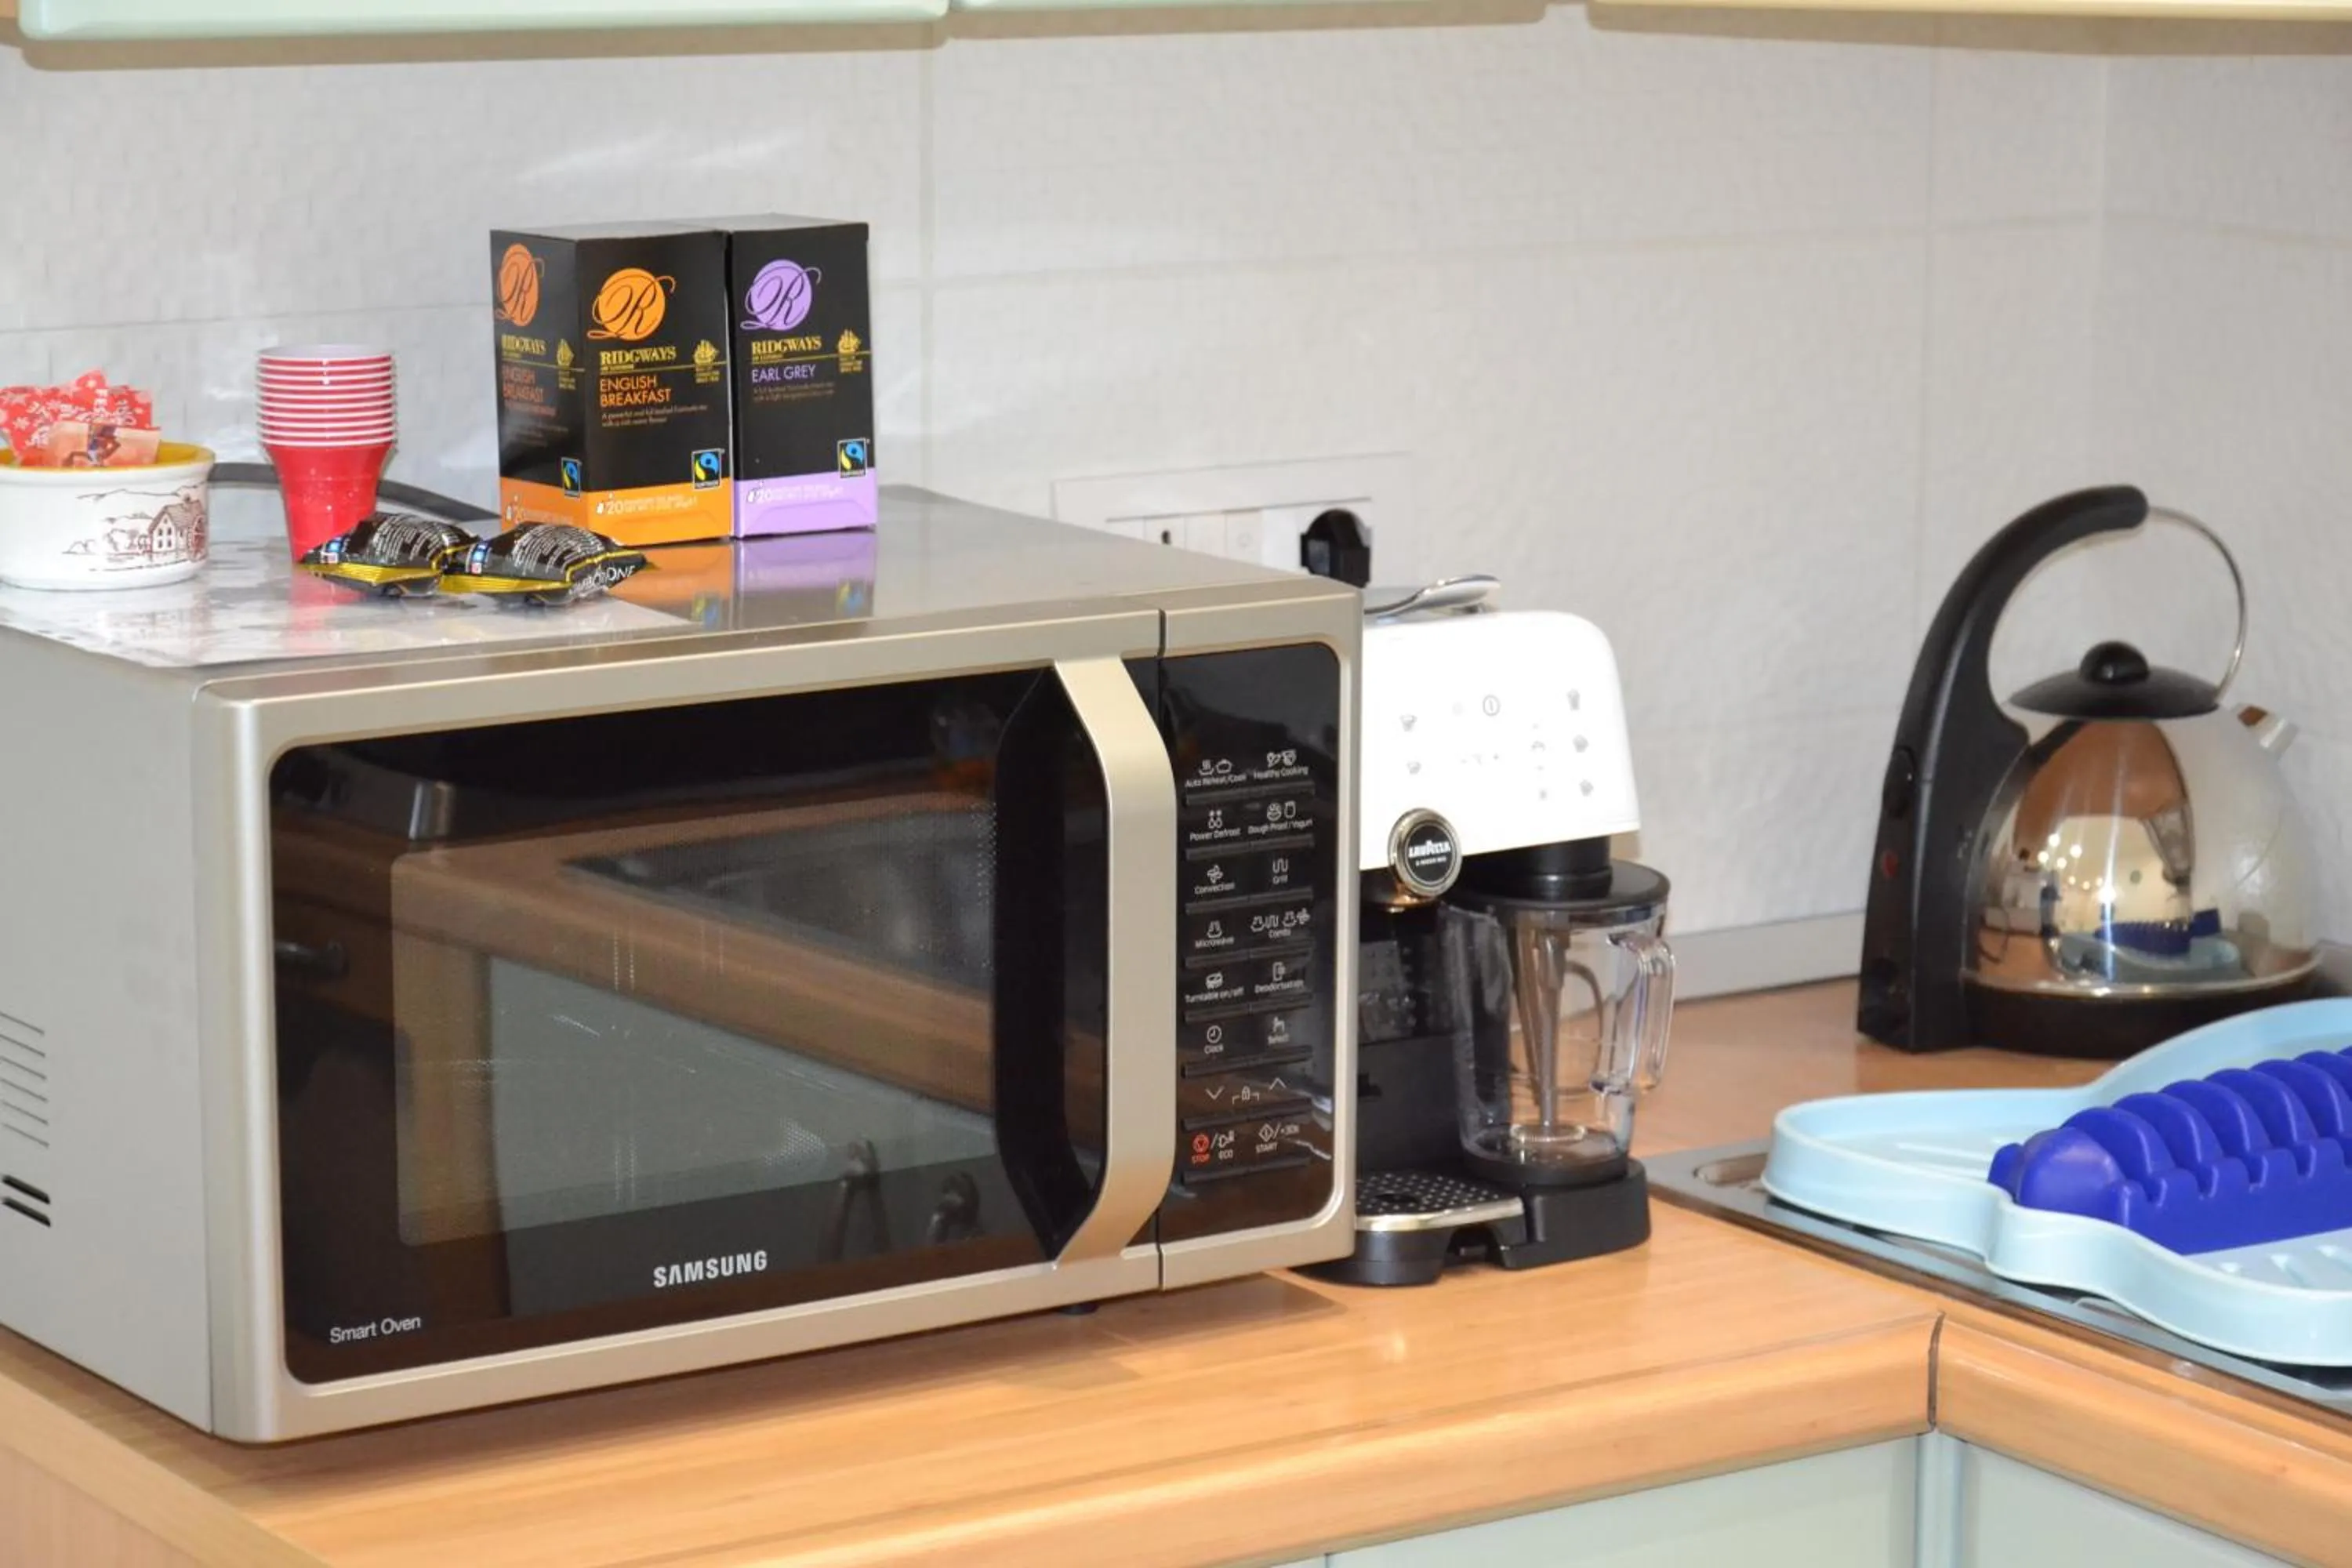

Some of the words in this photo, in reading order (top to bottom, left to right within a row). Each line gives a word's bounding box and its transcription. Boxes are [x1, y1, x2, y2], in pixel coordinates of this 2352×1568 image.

[502, 334, 546, 355] RIDGWAYS
[752, 336, 822, 354] RIDGWAYS
[600, 346, 677, 365] RIDGWAYS
[752, 366, 781, 383] EARL
[784, 363, 816, 380] GREY
[600, 375, 657, 392] ENGLISH
[600, 388, 672, 408] BREAKFAST
[606, 499, 623, 515] 20
[1280, 765, 1308, 778] Cooking
[1185, 778, 1202, 788] Auto
[1189, 831, 1212, 841] Power
[1214, 827, 1241, 839] Defrost
[1408, 840, 1451, 858] LAVAZZA
[1194, 881, 1236, 895] Convection
[1195, 936, 1235, 949] Microwave
[1185, 990, 1218, 1004] Turntable
[1256, 1142, 1278, 1154] START
[653, 1250, 768, 1288] SAMSUNG
[329, 1321, 376, 1343] Smart
[380, 1317, 421, 1335] Oven
